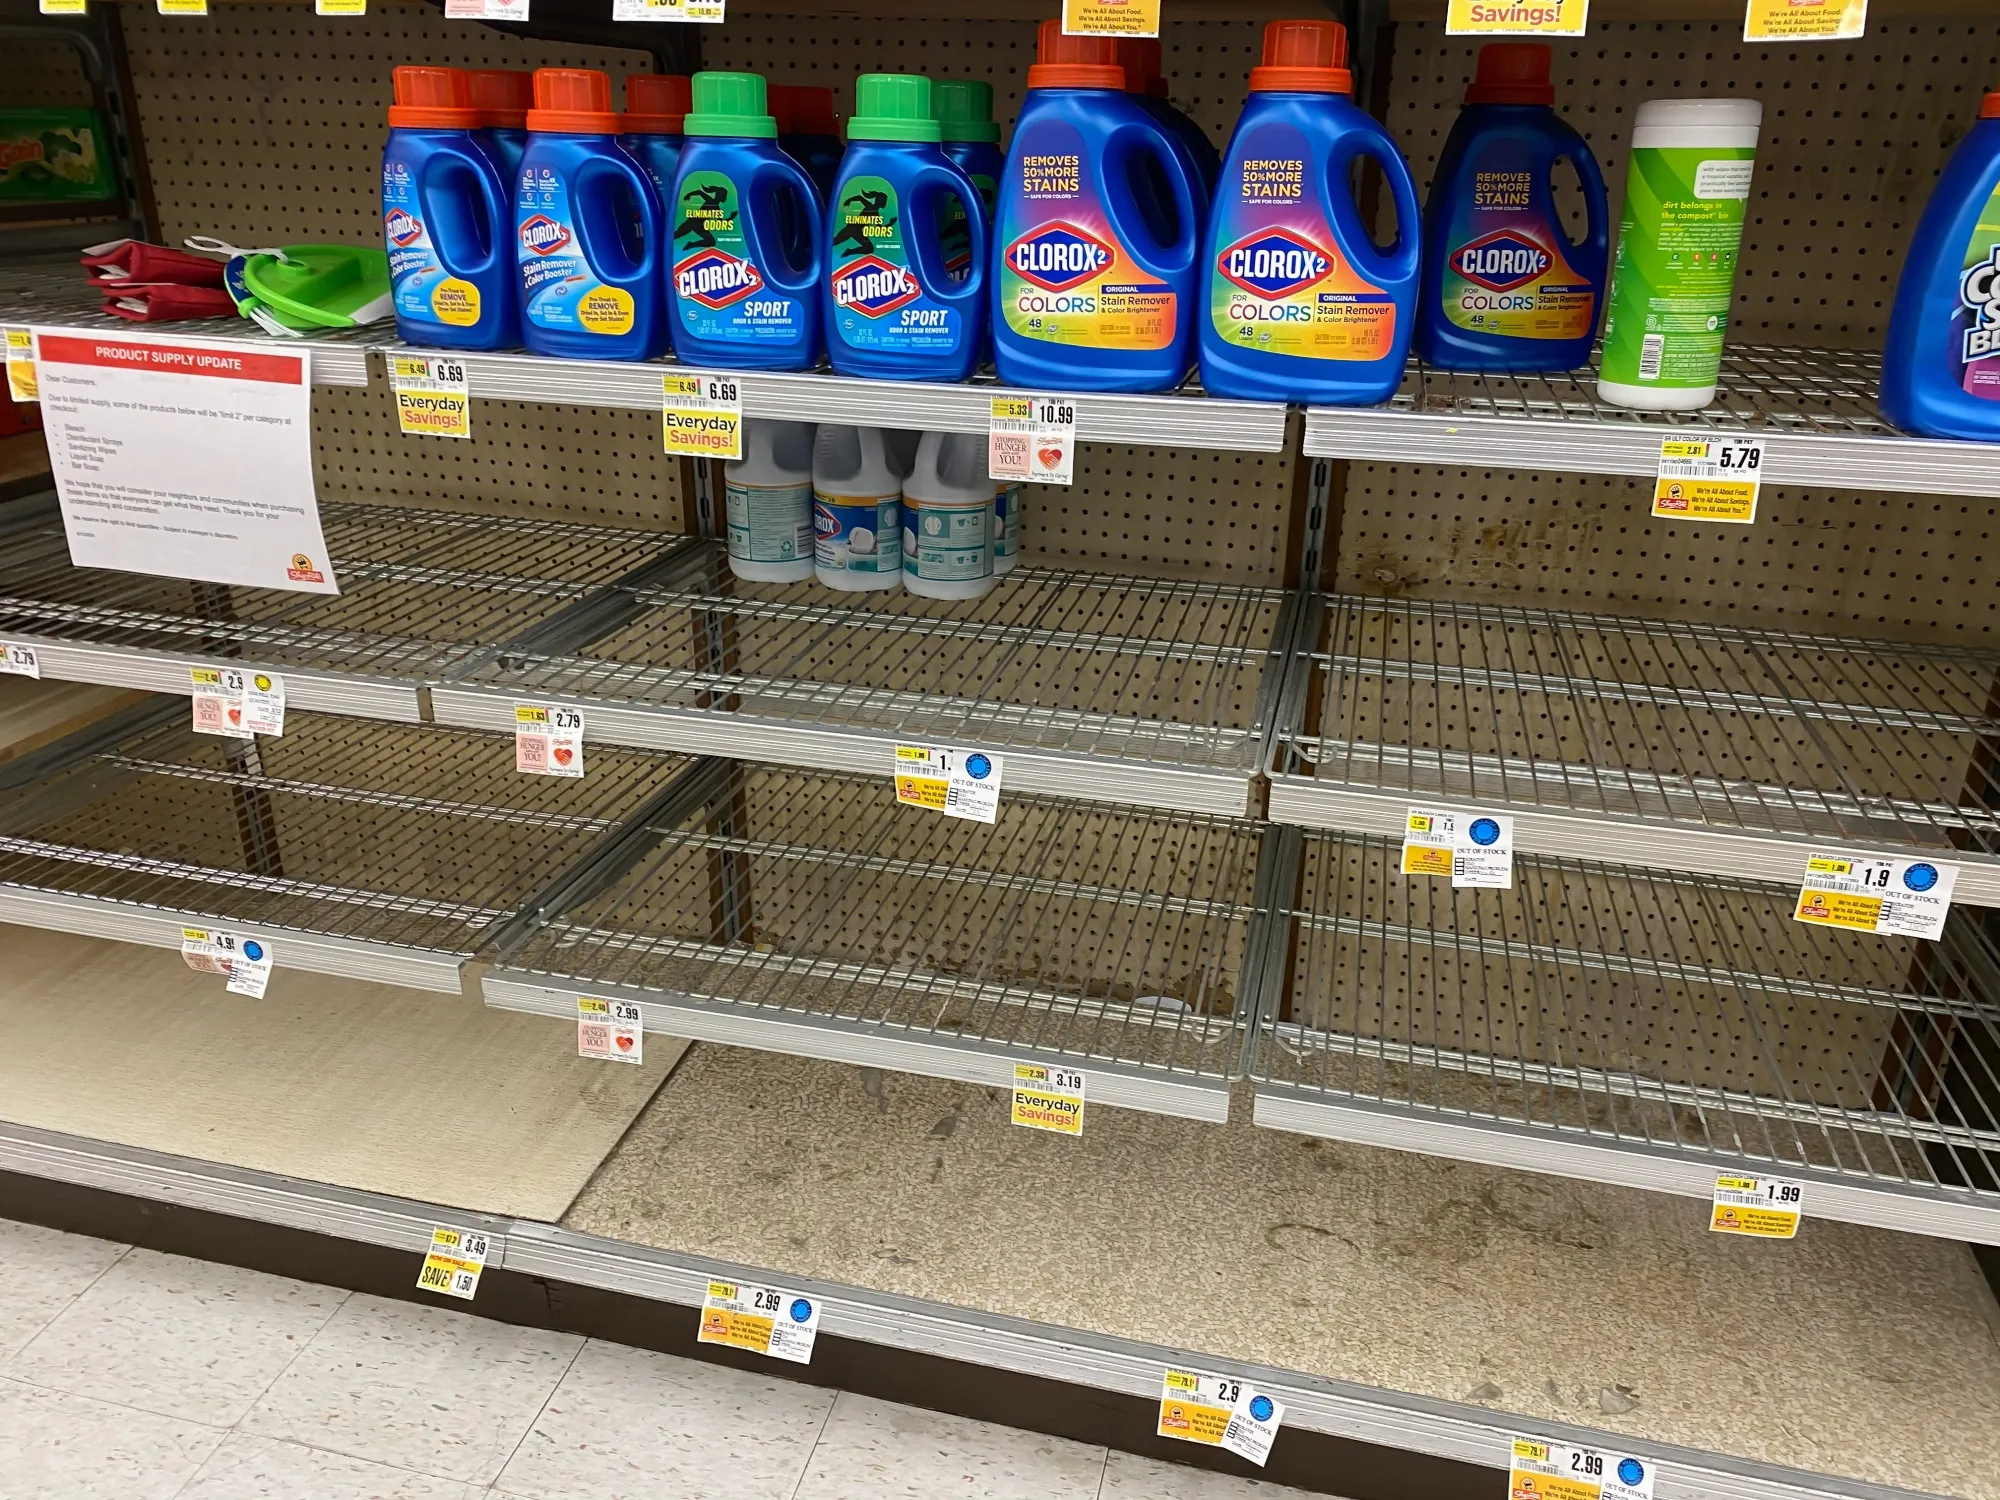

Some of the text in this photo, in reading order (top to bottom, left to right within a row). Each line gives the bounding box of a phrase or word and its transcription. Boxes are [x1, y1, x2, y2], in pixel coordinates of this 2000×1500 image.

[1470, 4, 1562, 25] Savings!
[1023, 155, 1079, 167] REMOVES
[1243, 160, 1303, 171] REMOVES
[1476, 172, 1531, 182] REMOVES
[1474, 193, 1529, 205] STAINS
[1663, 201, 1678, 209] dirt
[1680, 201, 1714, 211] belongs
[685, 208, 724, 219] ELIMINATES
[845, 215, 884, 225] ELIMINATES
[1661, 211, 1729, 219] the bin
[703, 219, 734, 231] ODORS
[862, 225, 893, 238] ODORS
[401, 250, 428, 261] Remover
[523, 259, 577, 277] Stain Remover
[527, 268, 573, 288] Color Booster
[440, 293, 467, 301] REMOVE
[1020, 287, 1034, 295] FOR
[1018, 296, 1096, 313] COLORS
[1100, 296, 1171, 306] Stain Remover
[1232, 294, 1247, 302] FOR
[1461, 296, 1534, 311] COLORS
[1538, 296, 1558, 304] Stain
[744, 301, 790, 317] SPORT
[1126, 306, 1161, 314] Brightener
[1229, 304, 1311, 322] COLORS
[1317, 305, 1390, 315] Stain Remover
[900, 309, 948, 326] SPORT
[1028, 319, 1042, 328] 48
[1470, 315, 1484, 324] 48
[1239, 326, 1254, 336] 48
[95, 346, 242, 371] PRODUCT SUPPLY UPDATE
[45, 374, 61, 382] Dear
[409, 363, 463, 382] 6.49 6.69
[679, 381, 737, 401] 6.49 6.69
[48, 393, 61, 402] Due
[69, 396, 89, 405] limited
[90, 399, 111, 408] supply,
[150, 405, 176, 414] products
[177, 406, 196, 415] below
[255, 415, 283, 426] category
[399, 394, 465, 414] Everyday
[404, 409, 462, 429] Savings!
[1009, 403, 1073, 424] 5.33 10.99
[64, 423, 85, 432] Bleach
[666, 412, 737, 434] Everyday
[102, 437, 123, 447] Sprays
[670, 429, 733, 449] Savings!
[996, 436, 1026, 445] STOPPING
[97, 446, 117, 456] Wipes
[994, 442, 1027, 453] HUNGER
[69, 452, 105, 463] Liquid Soap
[999, 455, 1022, 465] YOU!
[1687, 446, 1761, 469] 2.81 5.79
[1719, 488, 1734, 496] About
[121, 496, 241, 516] everyone Thank
[126, 487, 305, 515] consider neighbors communities when purchasing
[12, 650, 35, 666] 2.79
[530, 711, 580, 729] 1.63 2.79
[520, 742, 546, 751] HUNGER
[523, 751, 541, 762] YOU!
[975, 781, 996, 792] STOCK
[1885, 890, 1941, 905] OUT OF STOCK
[616, 1005, 638, 1020] 2.99
[1056, 1073, 1081, 1089] 3.19
[1015, 1092, 1080, 1115] Everyday
[1018, 1105, 1076, 1126] Savings!
[1768, 1184, 1801, 1202] 1.99
[465, 1238, 486, 1255] 3.49
[422, 1265, 473, 1292] SAVE 1.50
[755, 1291, 781, 1312] 2.99
[796, 1324, 813, 1334] STOCK
[1253, 1422, 1273, 1436] STOCK
[1571, 1453, 1603, 1476] 2.99
[1605, 1482, 1649, 1500] OUT OF STOCK
